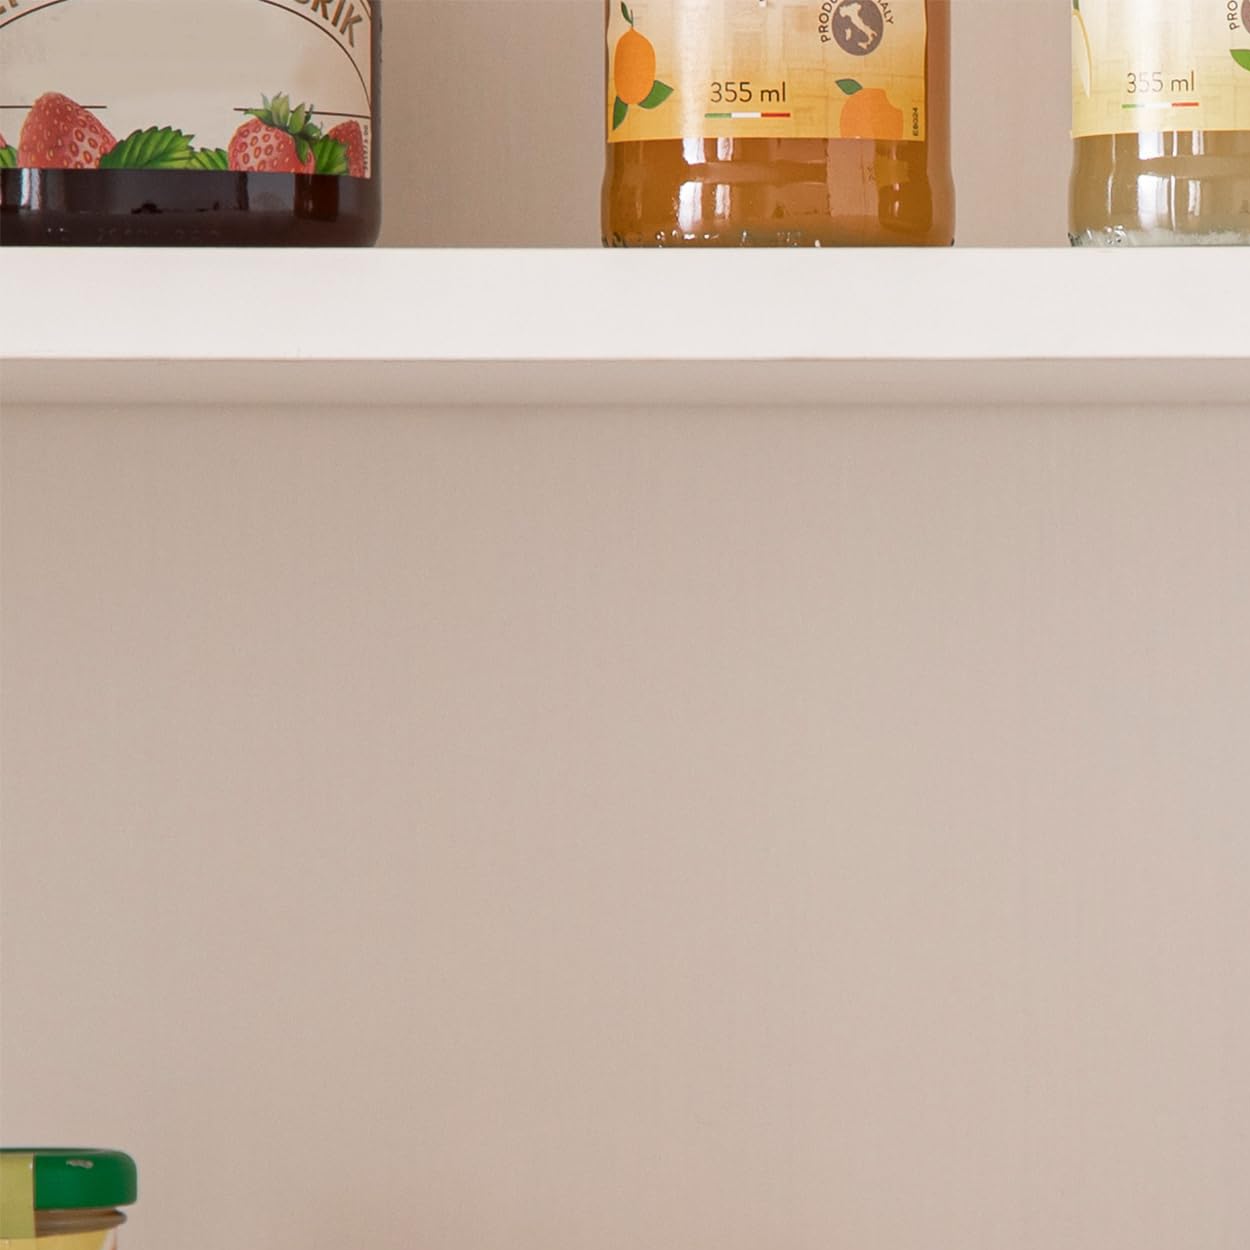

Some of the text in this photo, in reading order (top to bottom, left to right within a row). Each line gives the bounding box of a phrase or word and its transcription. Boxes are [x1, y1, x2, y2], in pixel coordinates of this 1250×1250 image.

[877, 0, 894, 24] ALY
[710, 81, 786, 102] 355 ml
[1127, 70, 1194, 93] 355 ml
